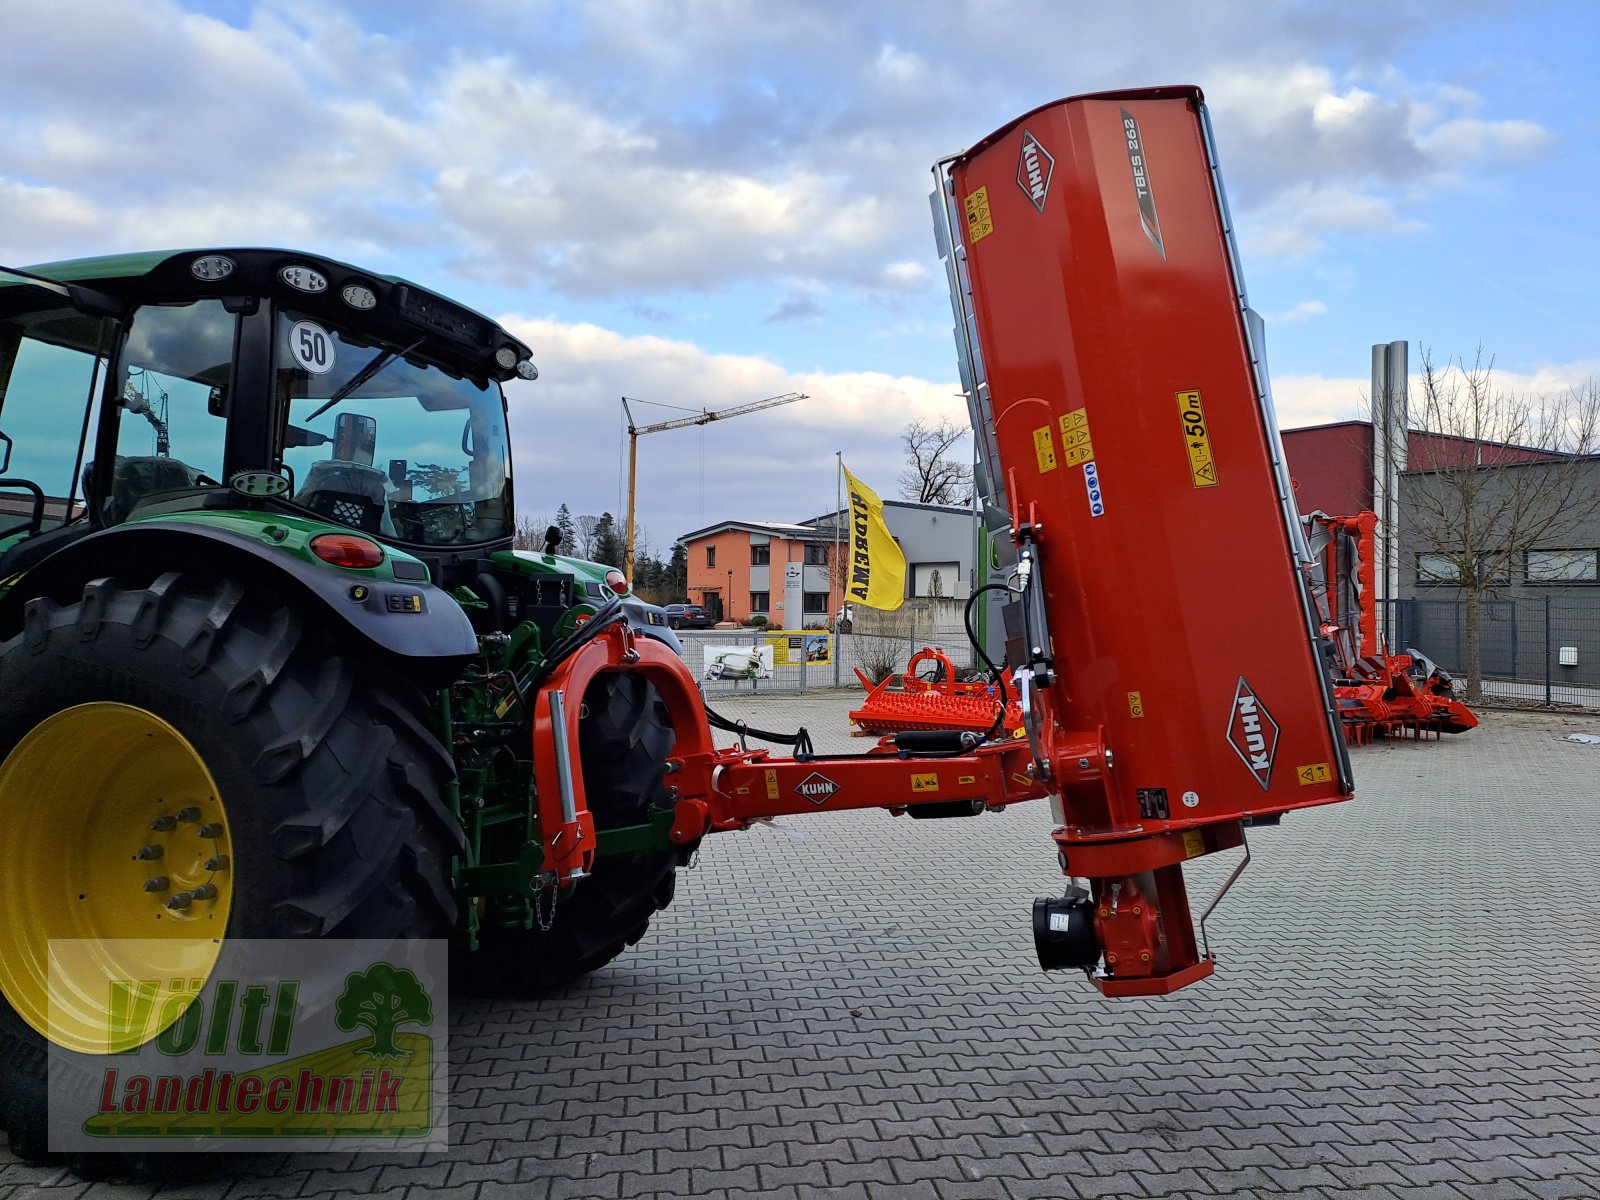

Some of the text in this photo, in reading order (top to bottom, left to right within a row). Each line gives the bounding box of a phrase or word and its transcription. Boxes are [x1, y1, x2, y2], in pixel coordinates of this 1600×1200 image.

[1023, 141, 1045, 200] KUHN
[1124, 118, 1148, 199] TBES 262
[300, 327, 326, 366] 50
[1183, 394, 1205, 437] 50 m
[1238, 695, 1270, 770] KUHN
[801, 782, 833, 795] KUHN
